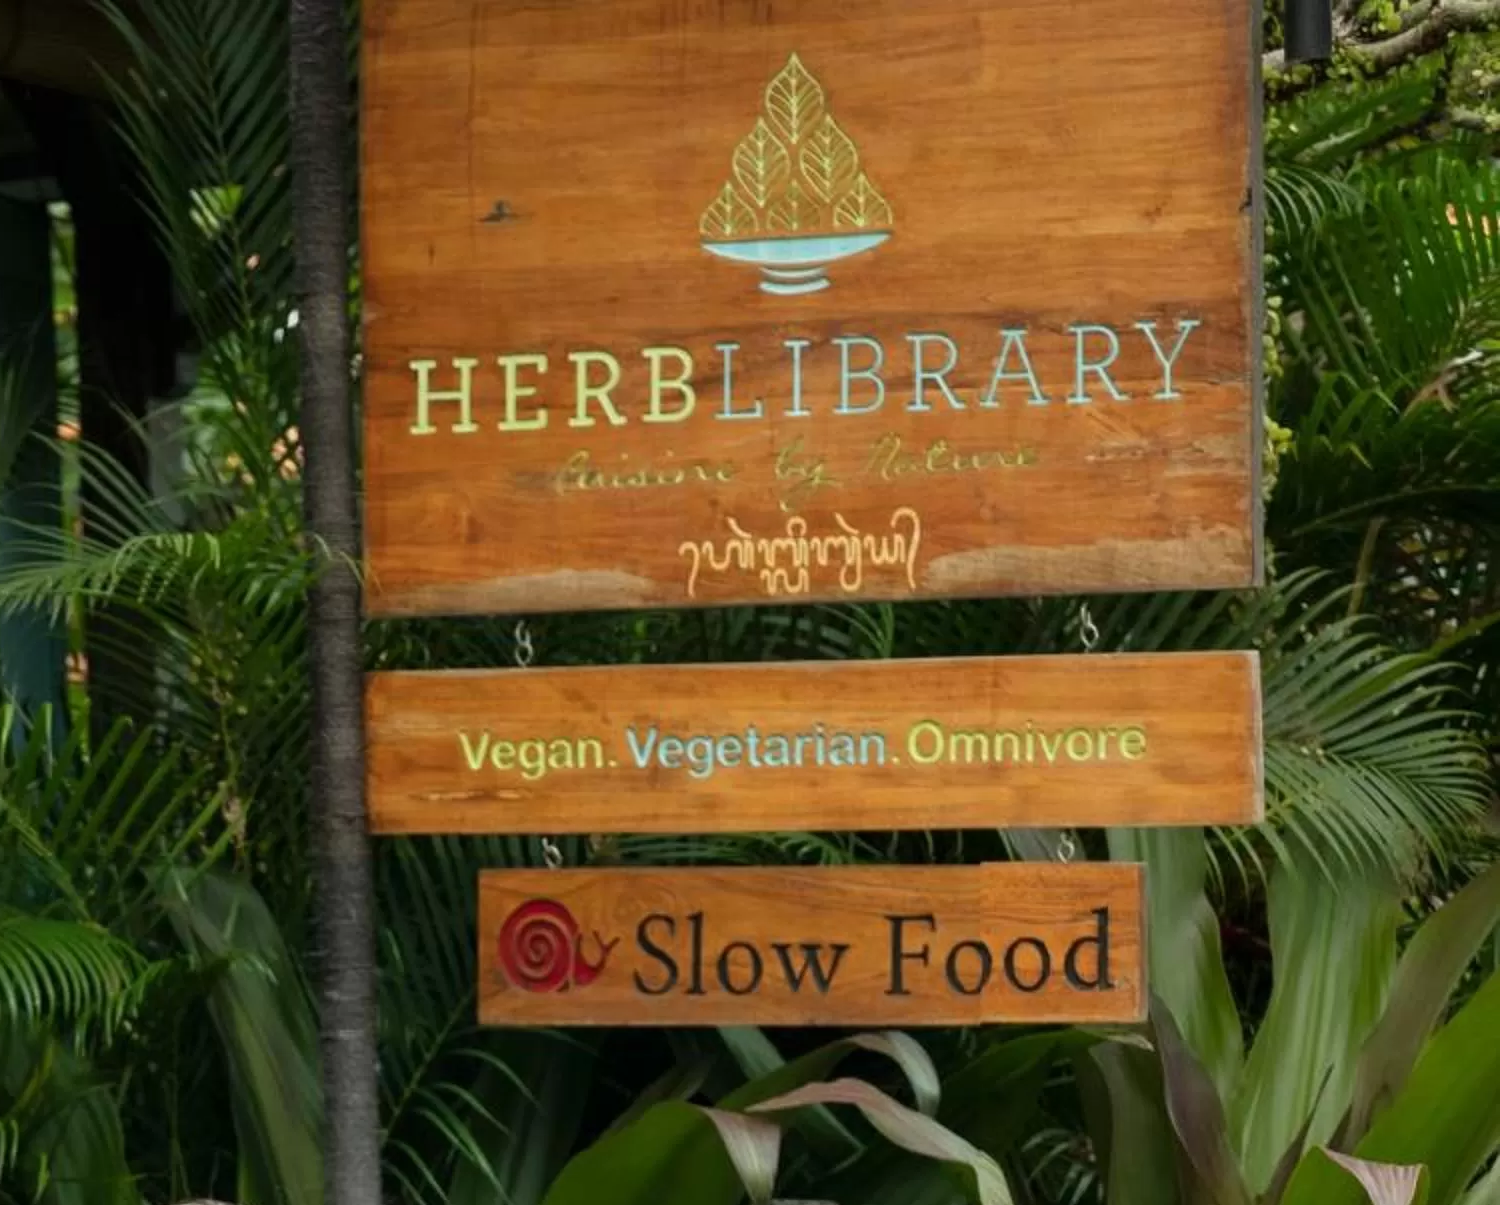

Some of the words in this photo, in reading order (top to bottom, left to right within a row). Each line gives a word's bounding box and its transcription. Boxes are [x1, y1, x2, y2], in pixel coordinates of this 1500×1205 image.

[774, 434, 845, 513] by
[907, 720, 1147, 764] Omnivore
[631, 910, 852, 996] Slow
[883, 906, 1116, 996] Food
